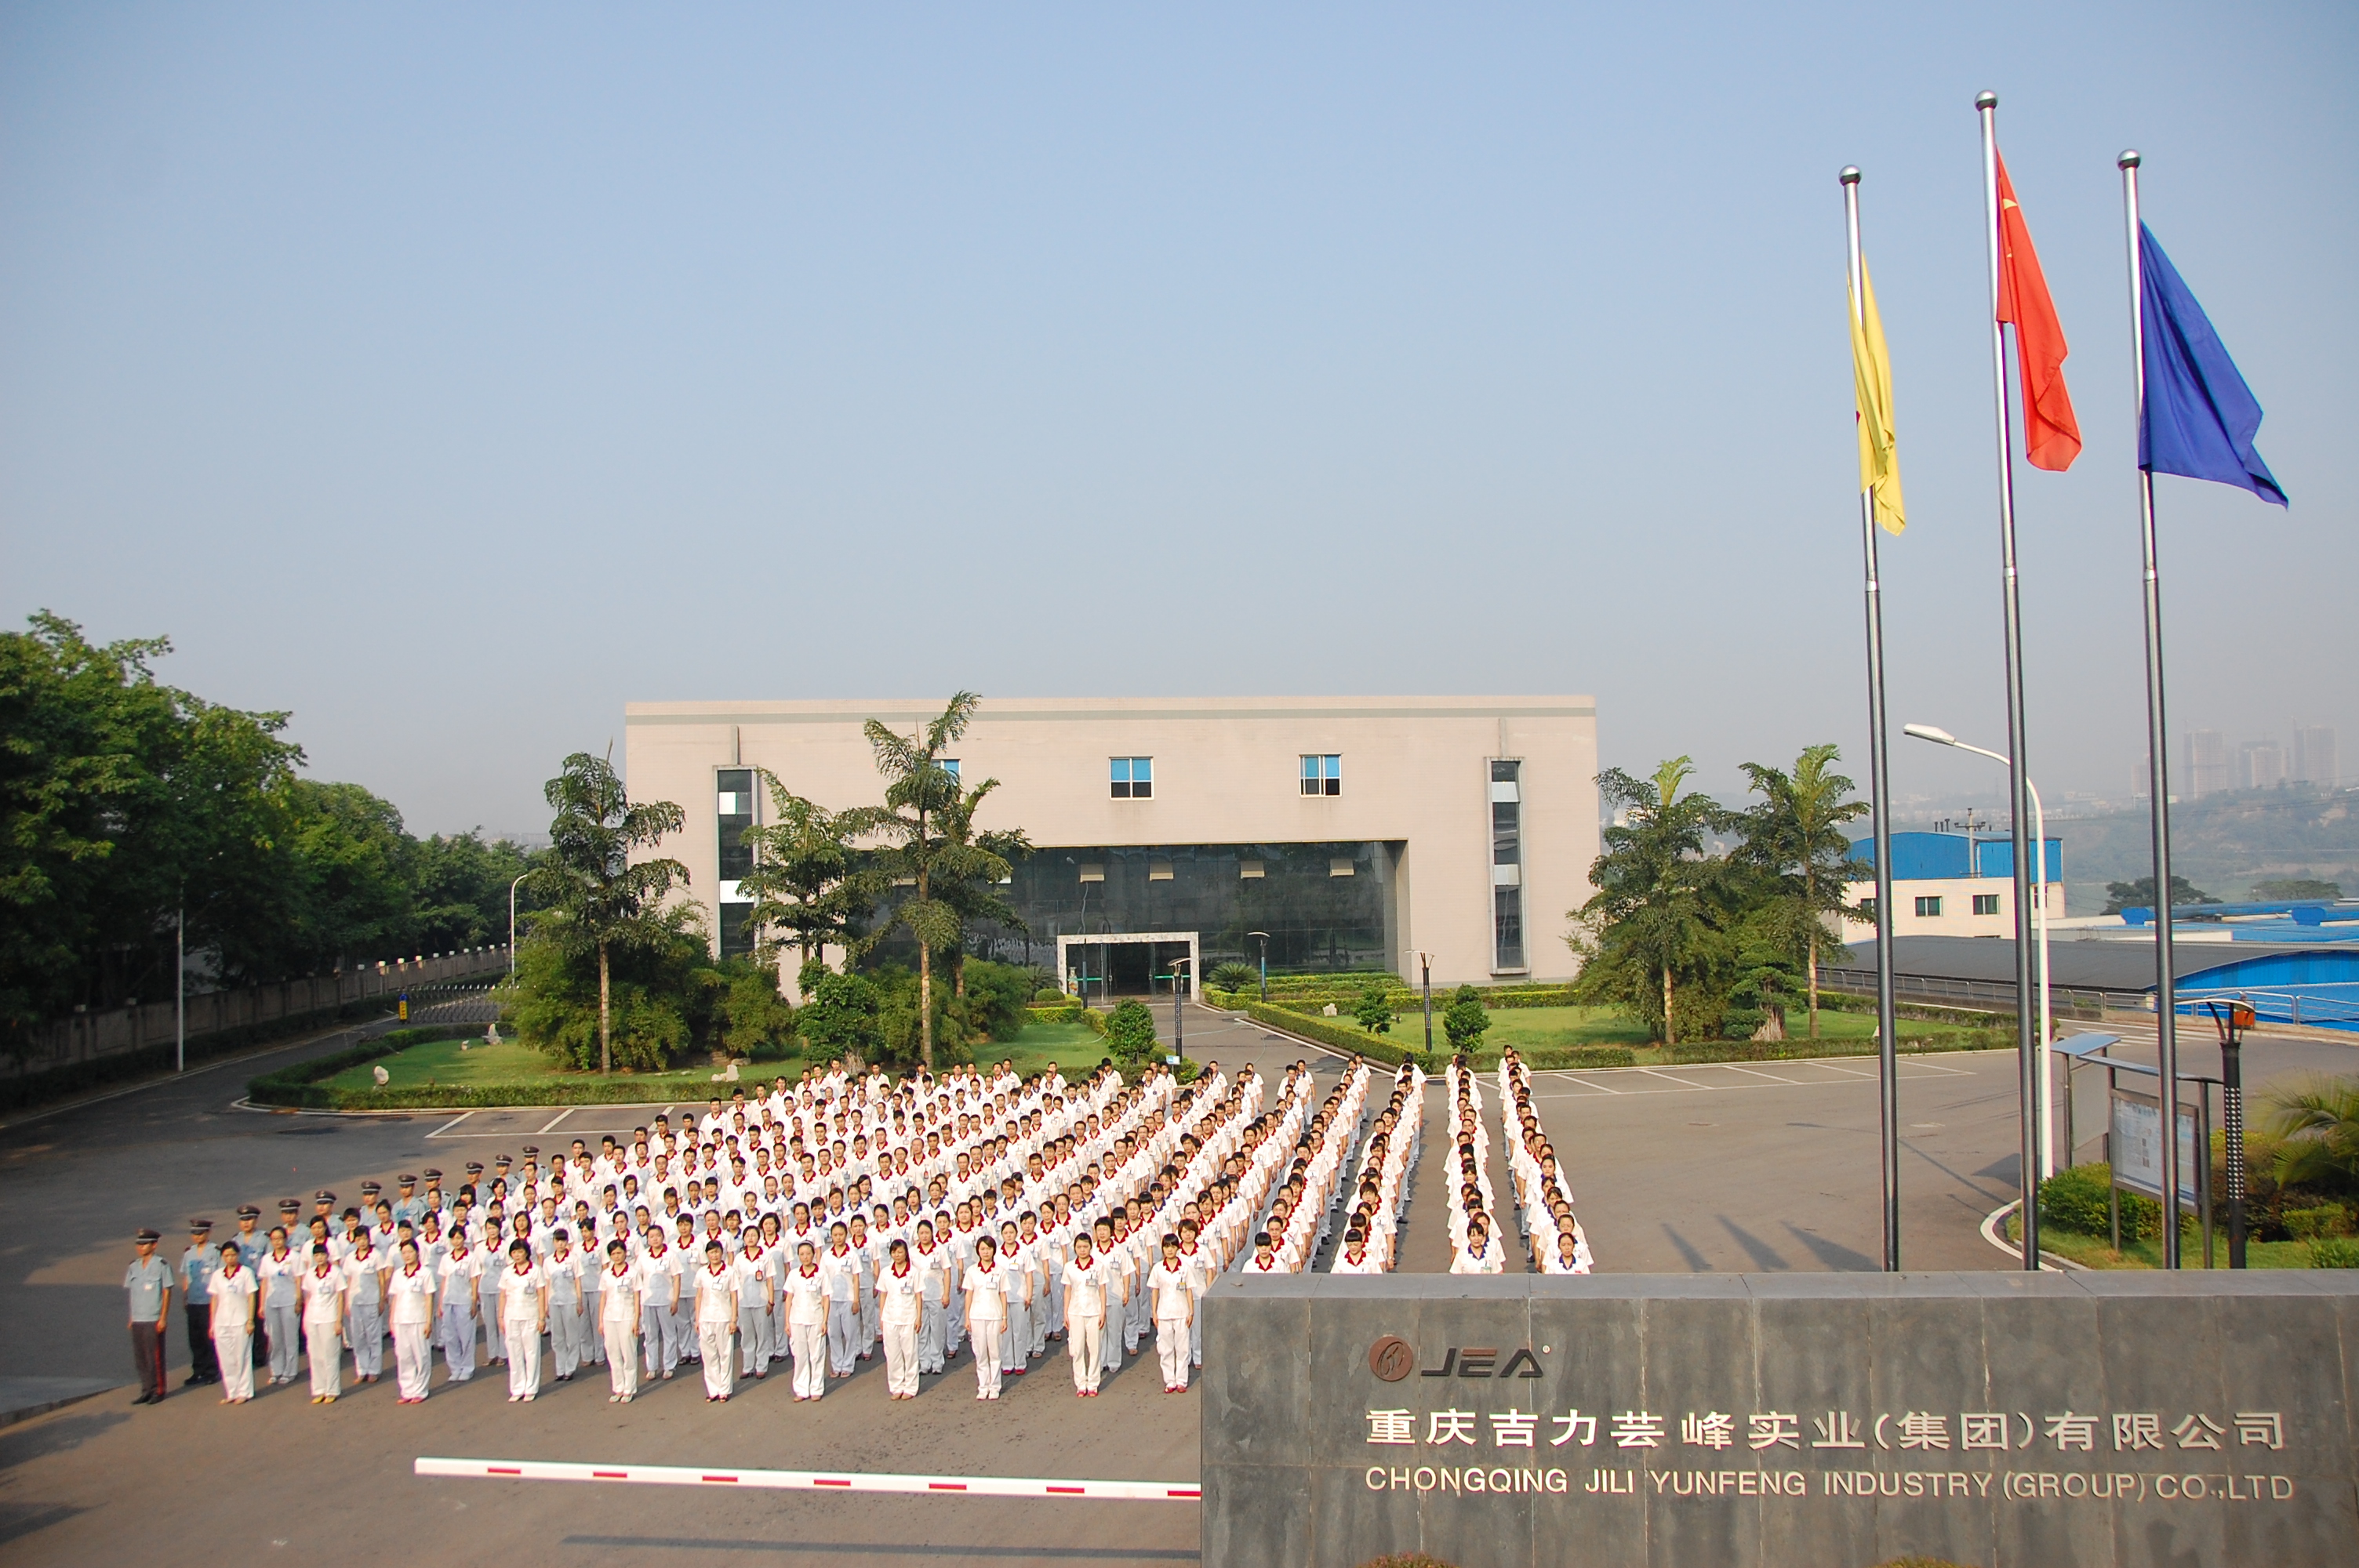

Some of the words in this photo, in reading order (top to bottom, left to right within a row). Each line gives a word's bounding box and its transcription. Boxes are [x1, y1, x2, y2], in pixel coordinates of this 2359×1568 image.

[1420, 1347, 1543, 1377] JEA
[1365, 1466, 1568, 1494] CHONGQING
[1585, 1469, 1634, 1494] JILI
[1650, 1471, 1806, 1496] YUNFENG
[1824, 1472, 1993, 1497] INDUSTRY
[2003, 1471, 2145, 1502] (GROUP)
